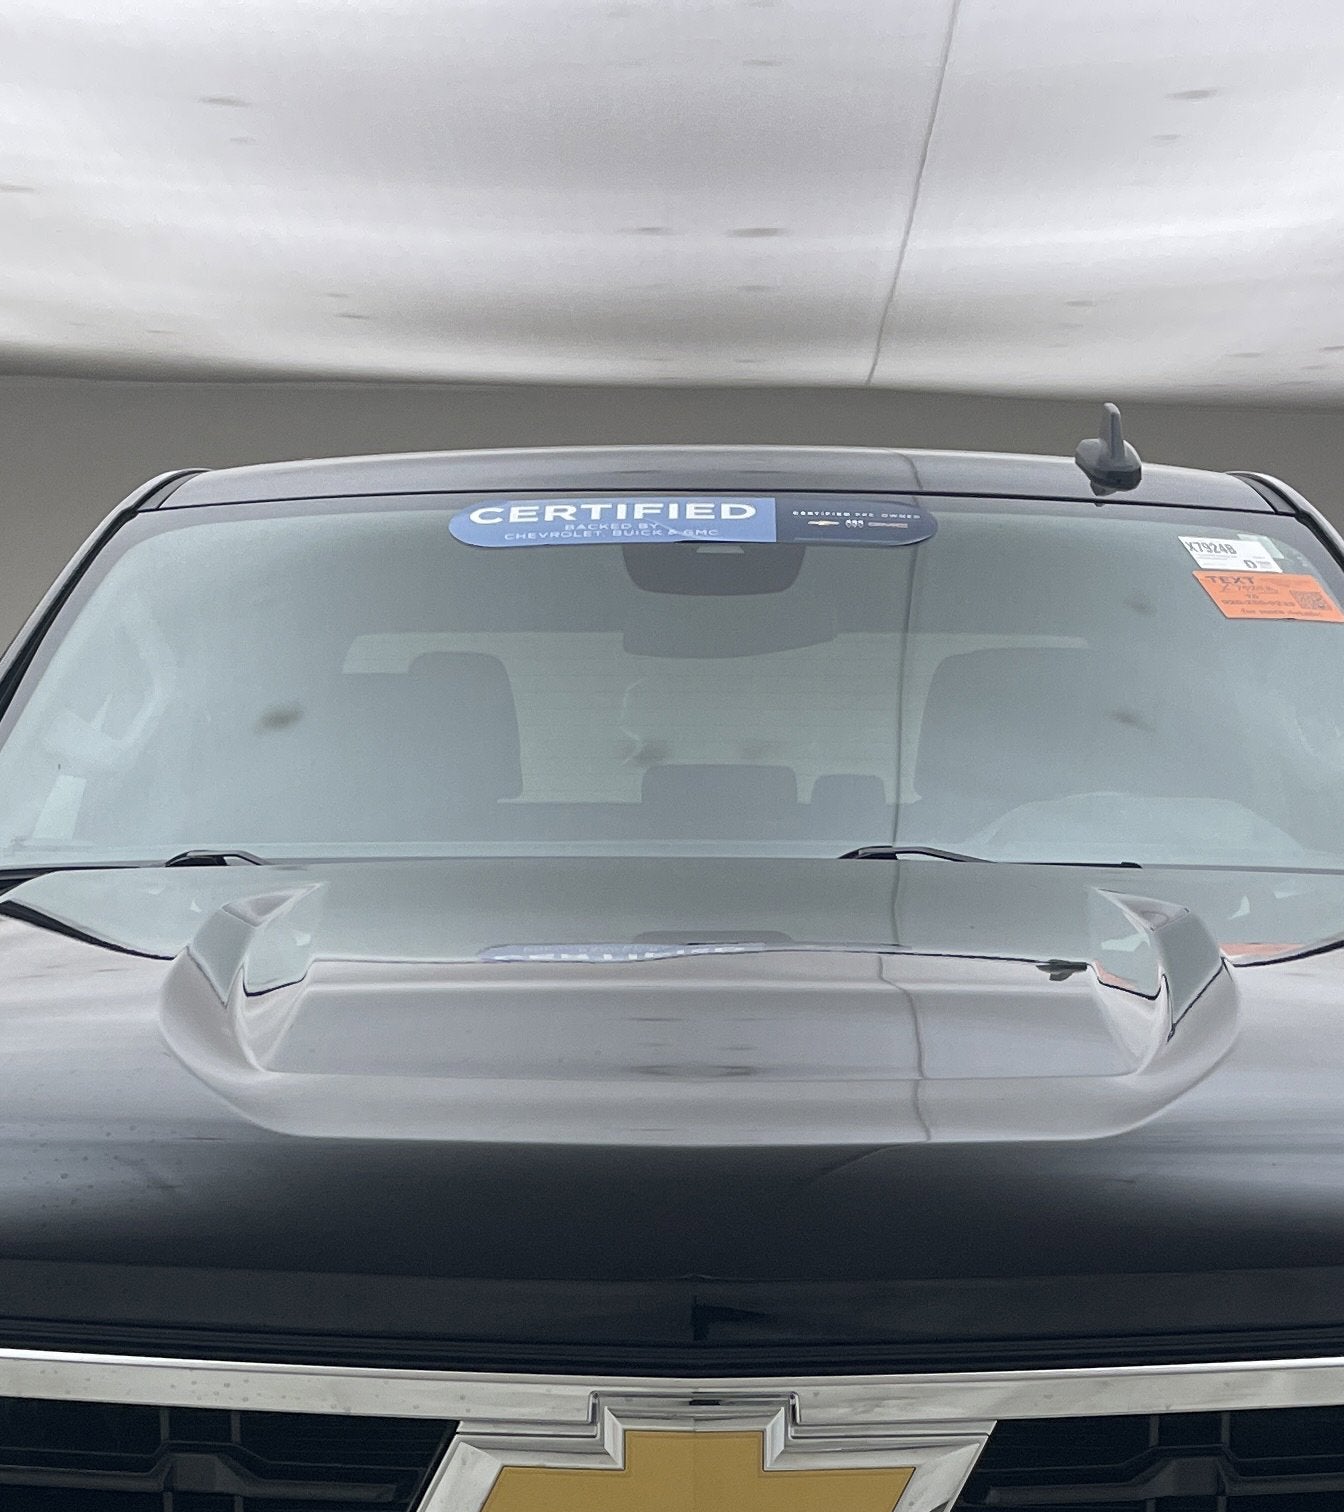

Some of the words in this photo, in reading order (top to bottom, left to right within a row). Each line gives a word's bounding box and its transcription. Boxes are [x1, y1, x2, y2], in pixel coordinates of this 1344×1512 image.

[469, 503, 757, 525] CERTIFIED
[564, 523, 633, 531] BACKED
[638, 522, 658, 530] BY
[612, 529, 663, 537] BUICK
[1185, 541, 1238, 555] X7924B
[1205, 575, 1255, 584] TEXT
